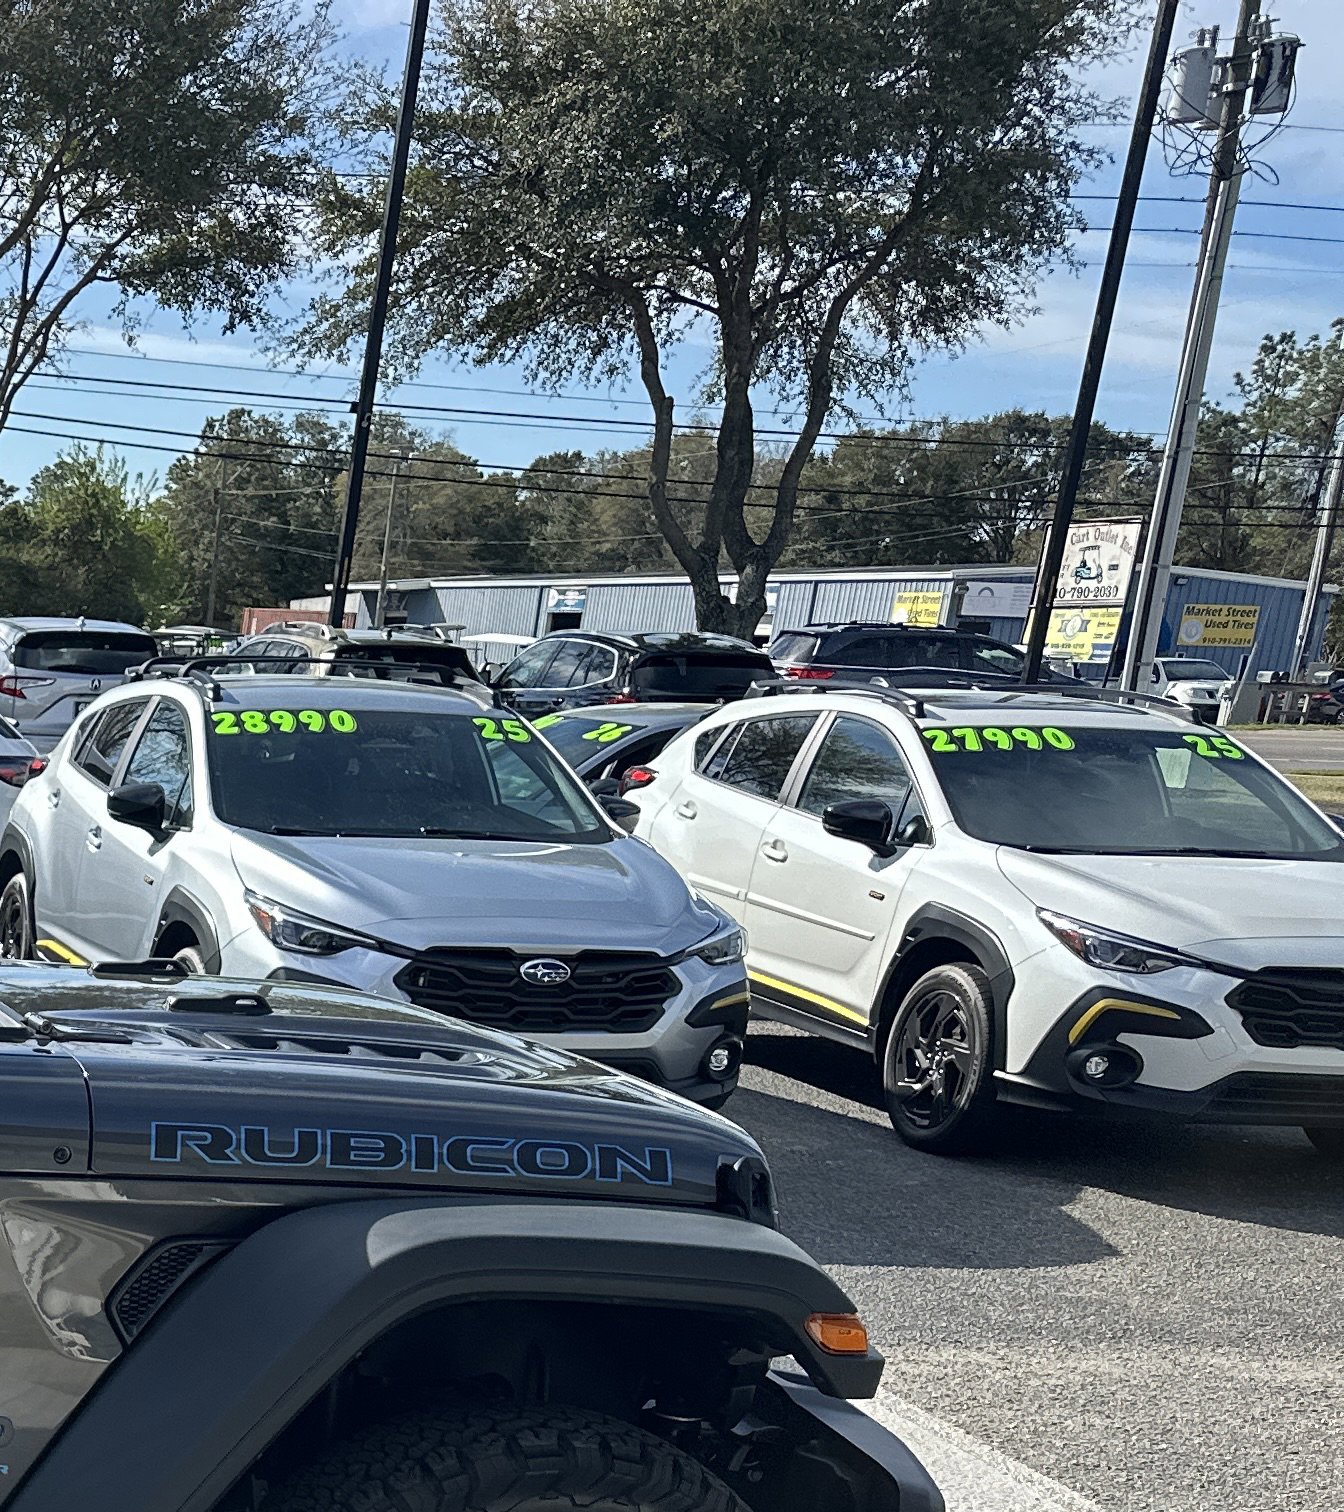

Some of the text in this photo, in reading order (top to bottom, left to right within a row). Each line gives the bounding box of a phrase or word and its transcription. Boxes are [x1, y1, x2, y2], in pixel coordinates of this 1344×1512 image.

[1070, 530, 1090, 546] Cart
[1094, 528, 1119, 545] Outlet
[1184, 606, 1258, 618] Market Street
[1204, 619, 1256, 630] Used Tires
[211, 710, 357, 735] 28990
[472, 717, 532, 744] 25
[922, 727, 1075, 752] 27990
[1182, 734, 1245, 760] 25
[149, 1120, 674, 1186] RUBICON
